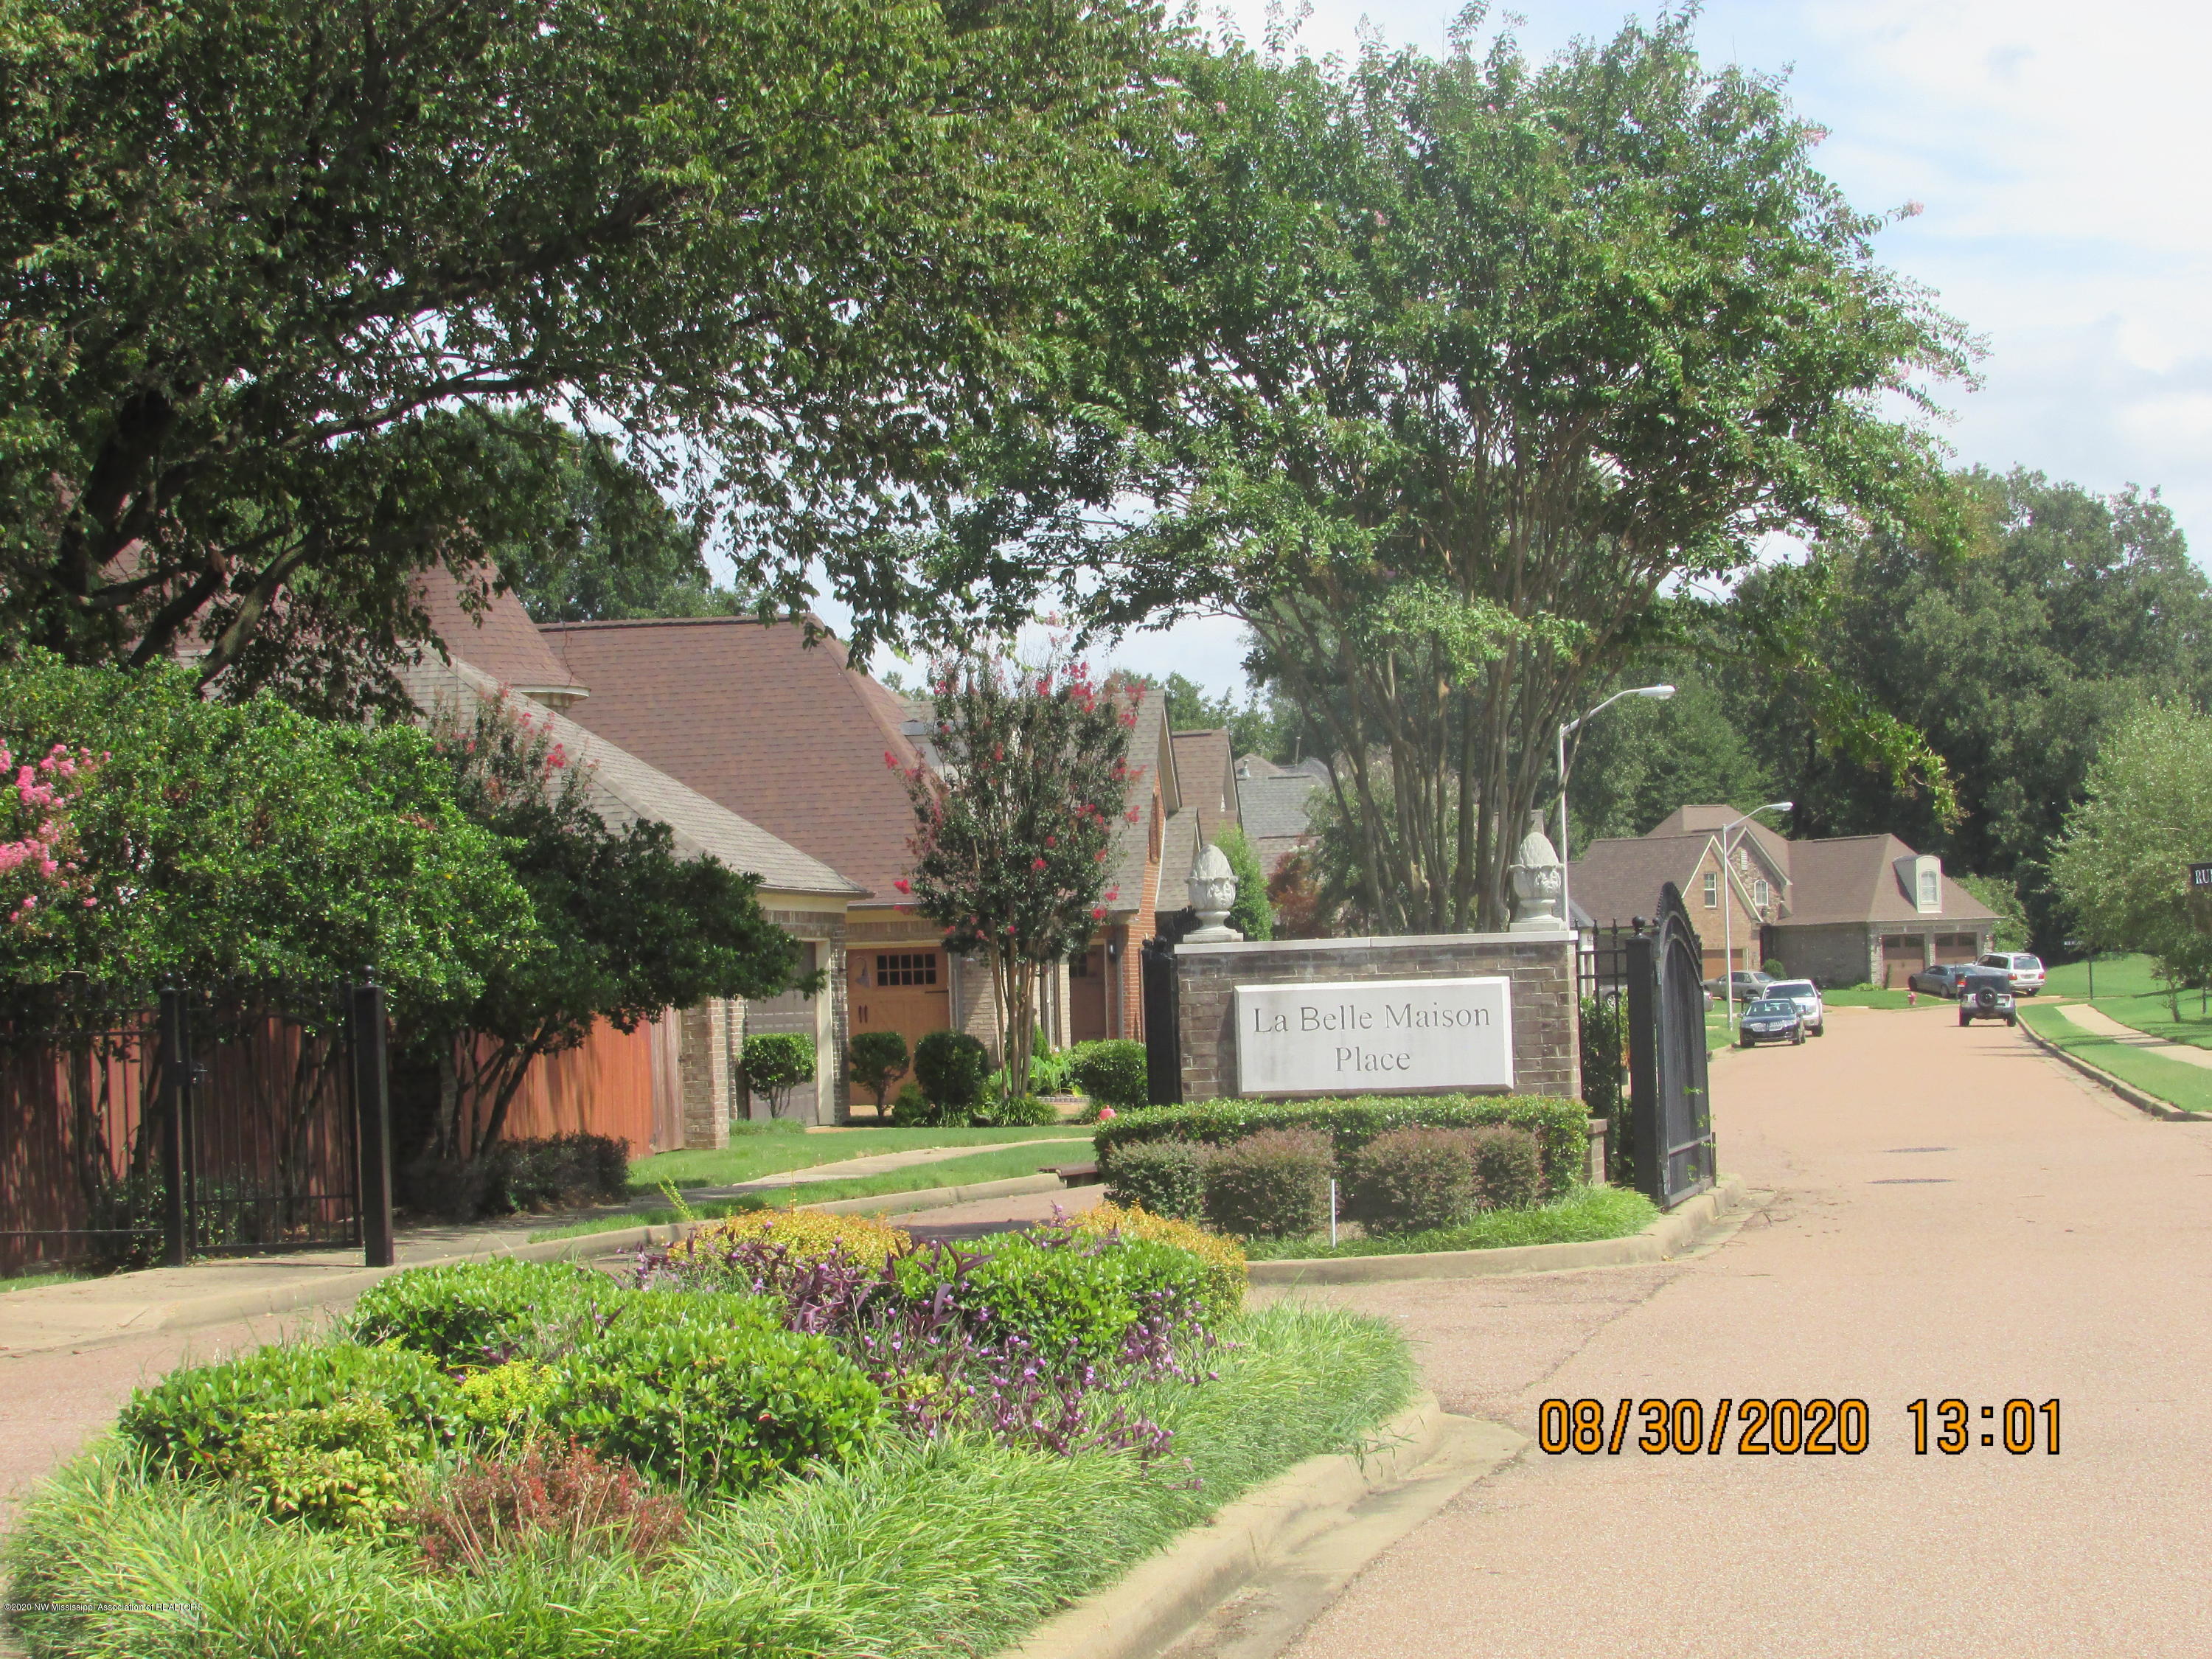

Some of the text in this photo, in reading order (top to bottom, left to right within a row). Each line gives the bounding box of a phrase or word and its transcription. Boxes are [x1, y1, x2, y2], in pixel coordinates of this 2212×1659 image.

[2195, 869, 2212, 885] RU
[1253, 1002, 1490, 1033] La Belle Maison
[1335, 1046, 1411, 1072] Place
